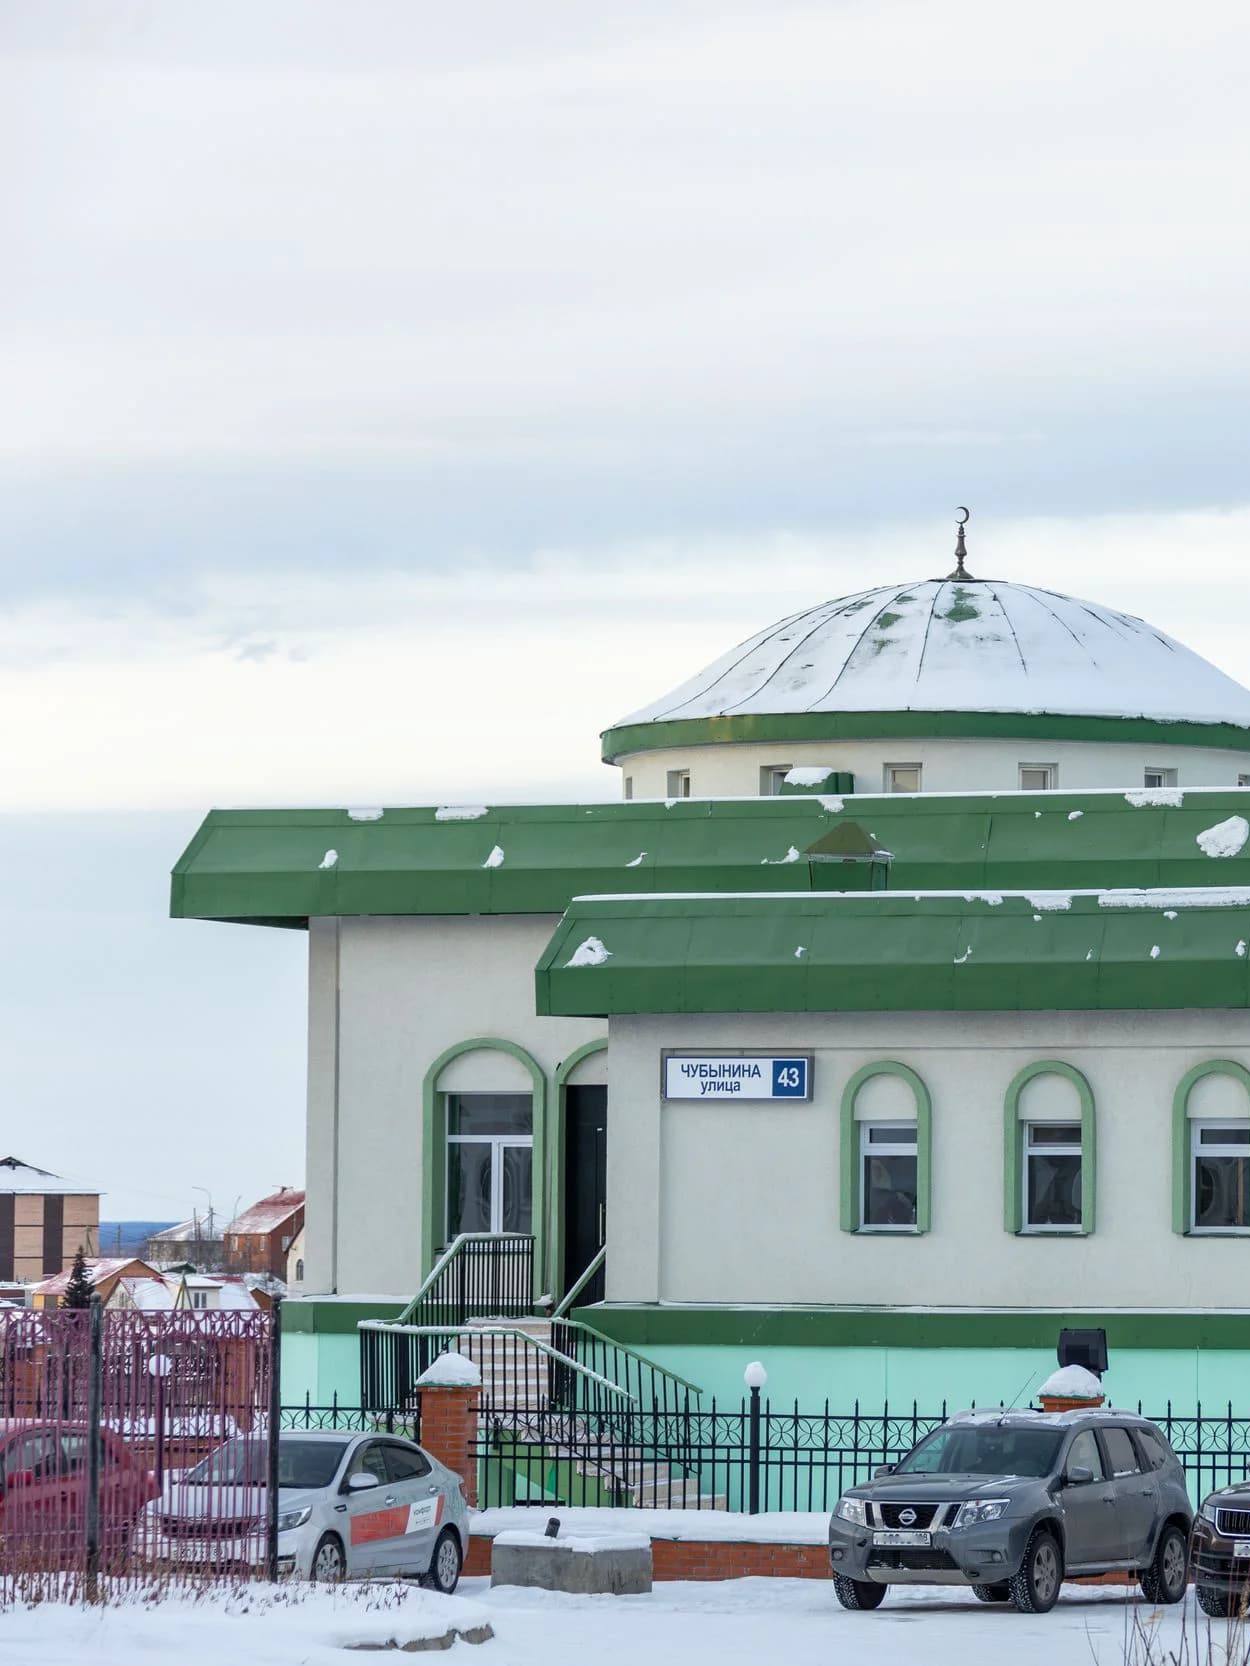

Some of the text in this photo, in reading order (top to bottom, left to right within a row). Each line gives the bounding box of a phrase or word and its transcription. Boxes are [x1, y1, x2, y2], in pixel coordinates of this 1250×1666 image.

[681, 1064, 761, 1078] ЧУБЫНИНА
[777, 1067, 800, 1087] 43
[700, 1081, 741, 1094] улица
